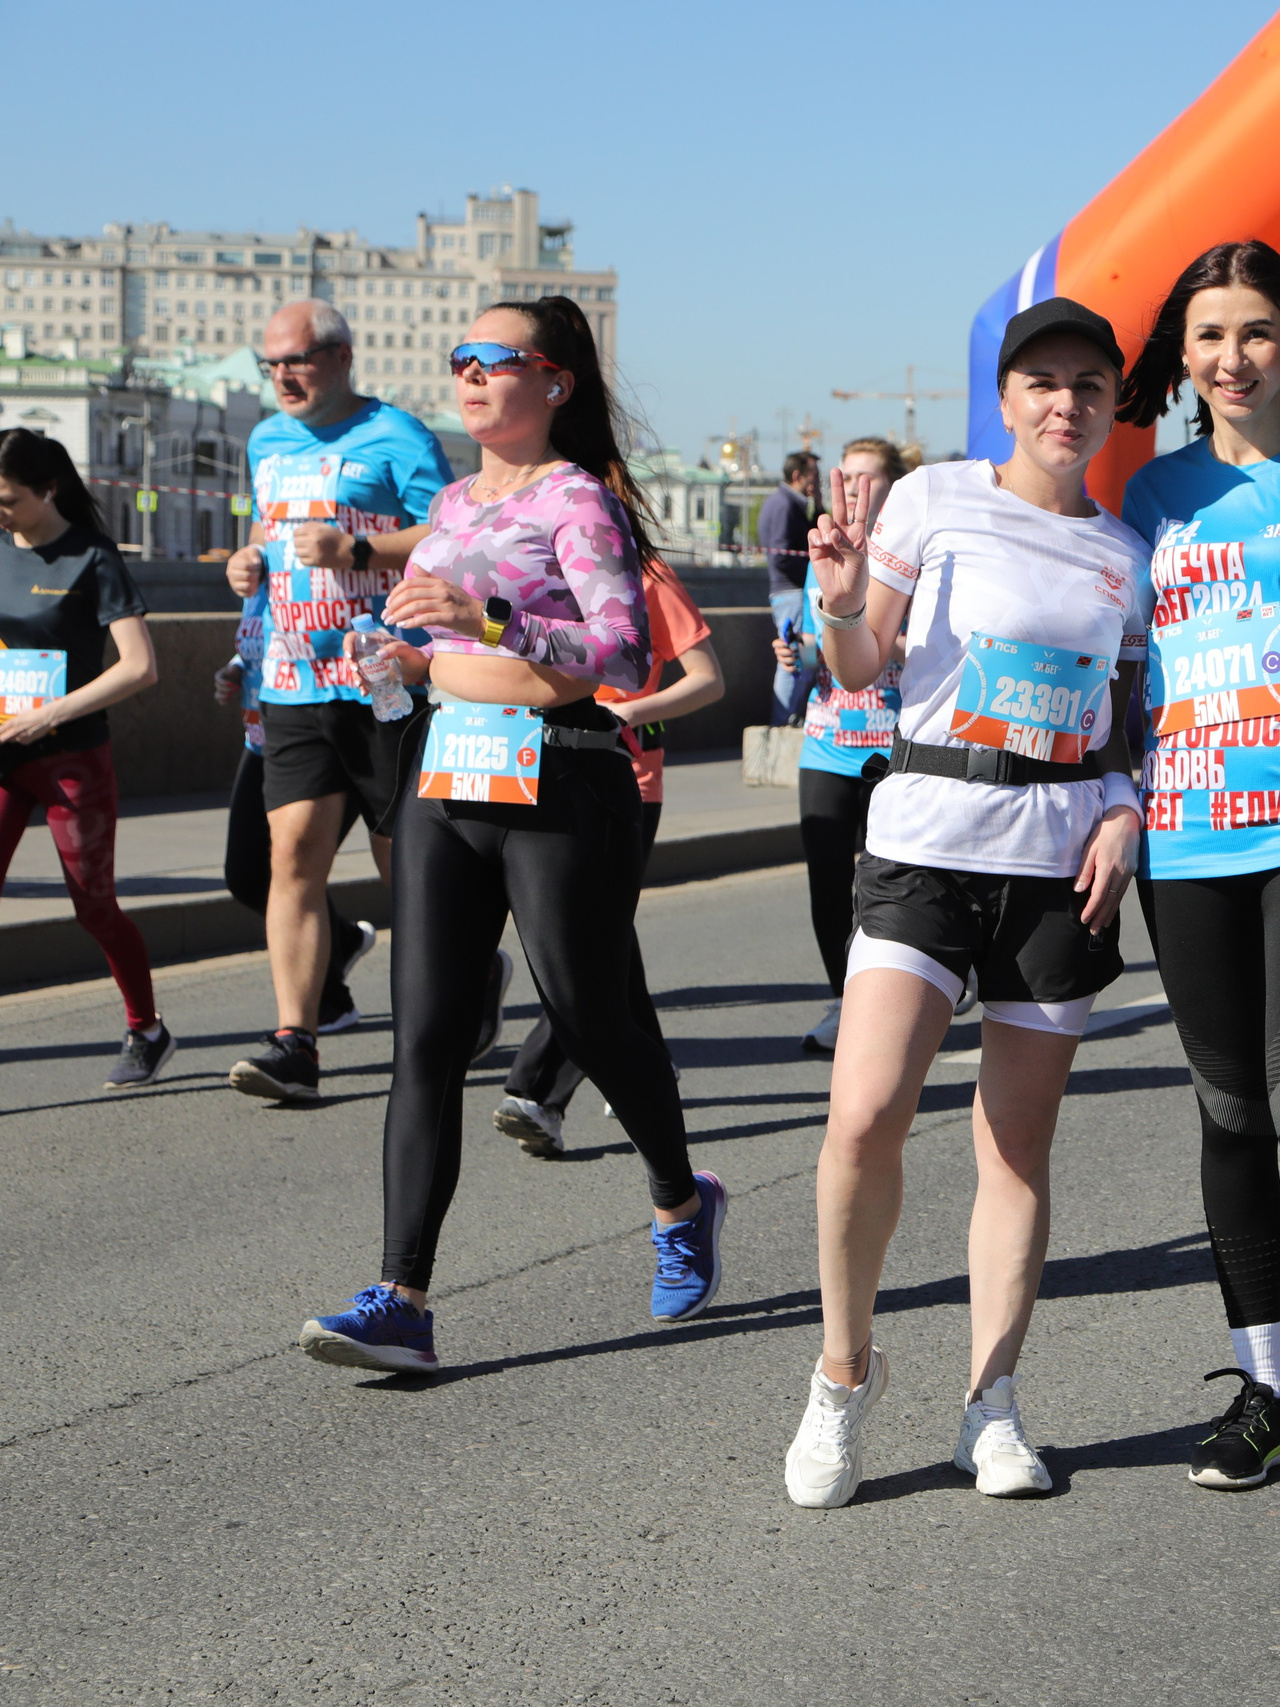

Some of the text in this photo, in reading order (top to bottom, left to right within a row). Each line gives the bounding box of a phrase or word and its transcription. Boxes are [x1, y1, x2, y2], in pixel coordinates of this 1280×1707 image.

[310, 568, 402, 600] #МОМЕН
[271, 598, 373, 632] ГОРДОСТЬ
[994, 642, 1018, 654] ПСБ
[1174, 643, 1257, 696] 24071
[990, 676, 1082, 727] 23391
[442, 733, 509, 771] 21125
[1140, 749, 1225, 790] ЮБОВЬ
[1145, 792, 1183, 830] БЕГ
